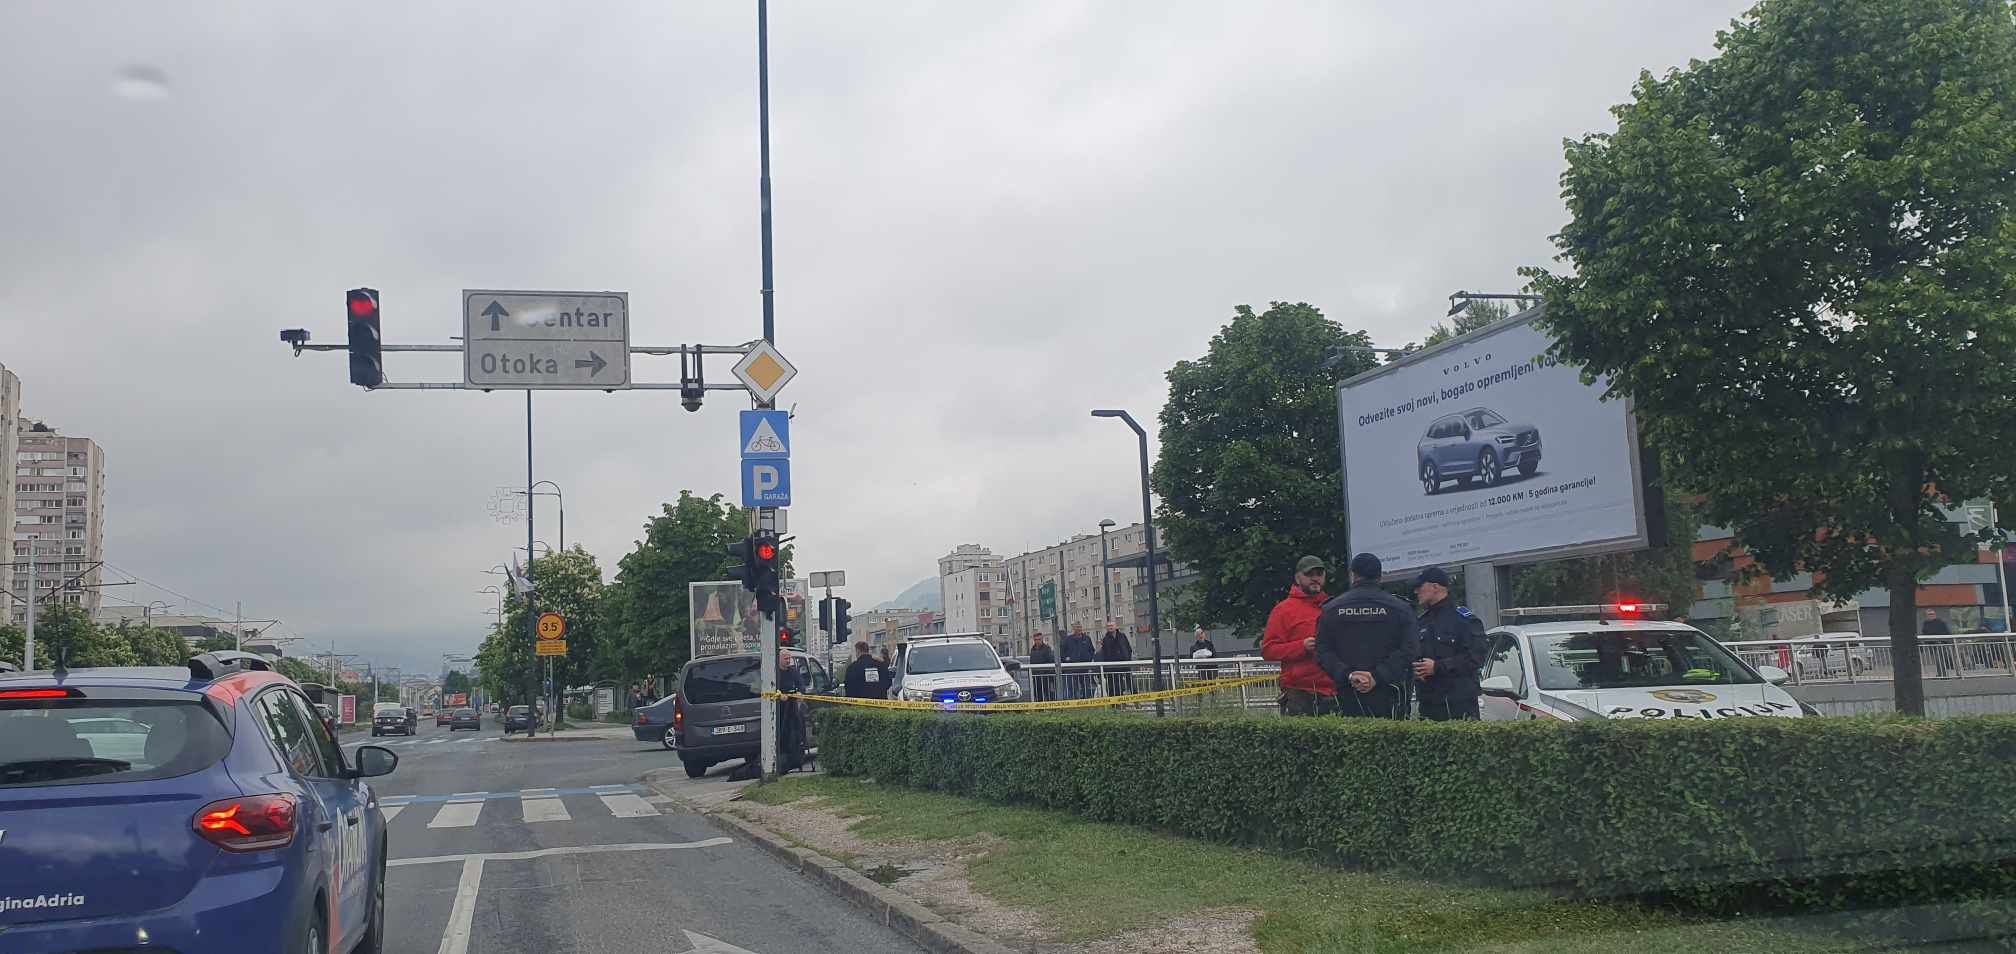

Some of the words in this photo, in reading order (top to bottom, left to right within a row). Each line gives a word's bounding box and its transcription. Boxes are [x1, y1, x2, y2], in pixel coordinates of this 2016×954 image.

[526, 307, 613, 328] entar
[480, 352, 559, 375] Otoka
[1442, 353, 1493, 376] VOLVO
[1358, 407, 1396, 427] Odvezite
[1397, 398, 1415, 413] svoj
[1440, 380, 1475, 400] bogato
[1477, 360, 1534, 390] opremljeni
[752, 465, 779, 500] P
[1488, 494, 1511, 505] 12.000
[1512, 491, 1524, 502] KM
[1528, 489, 1534, 498] 5
[1534, 486, 1558, 498] godina
[1338, 607, 1387, 617] POLICIJA
[1609, 701, 1794, 719] POLICIJA
